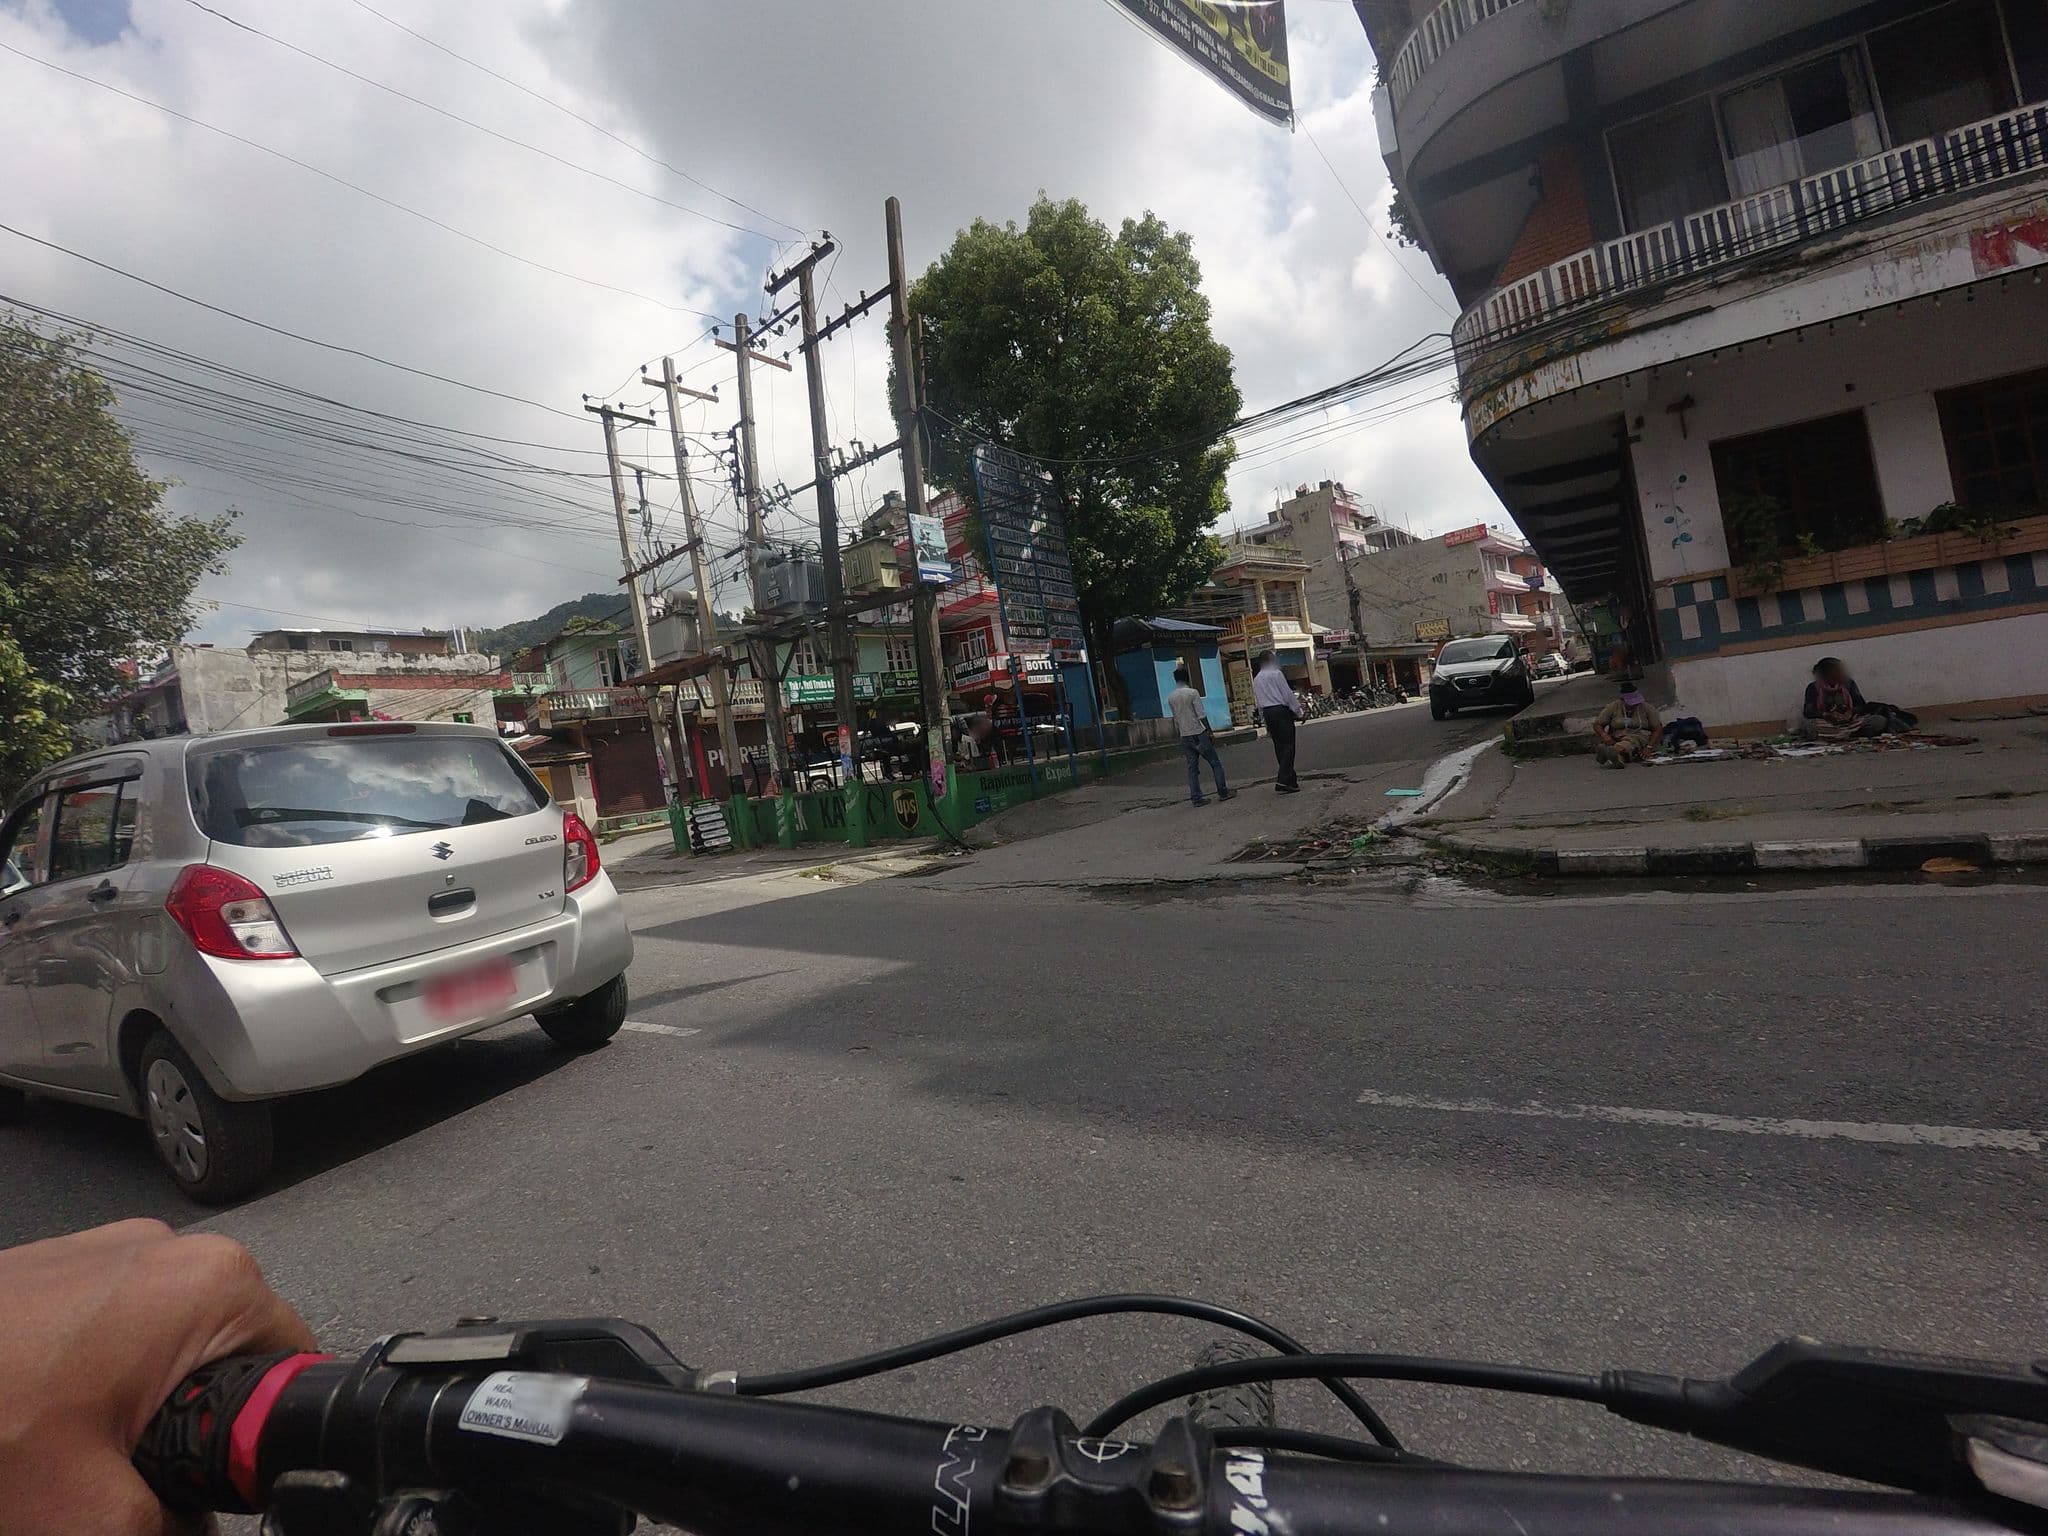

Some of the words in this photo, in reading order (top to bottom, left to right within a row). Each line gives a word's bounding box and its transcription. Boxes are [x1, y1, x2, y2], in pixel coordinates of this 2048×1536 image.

[954, 660, 973, 675] BOTTLE
[973, 656, 987, 670] SHOP
[1026, 660, 1059, 671] BOTTL
[733, 696, 766, 705] ARMAC
[493, 1383, 514, 1395] REA
[466, 1410, 512, 1429] OWNER'S
